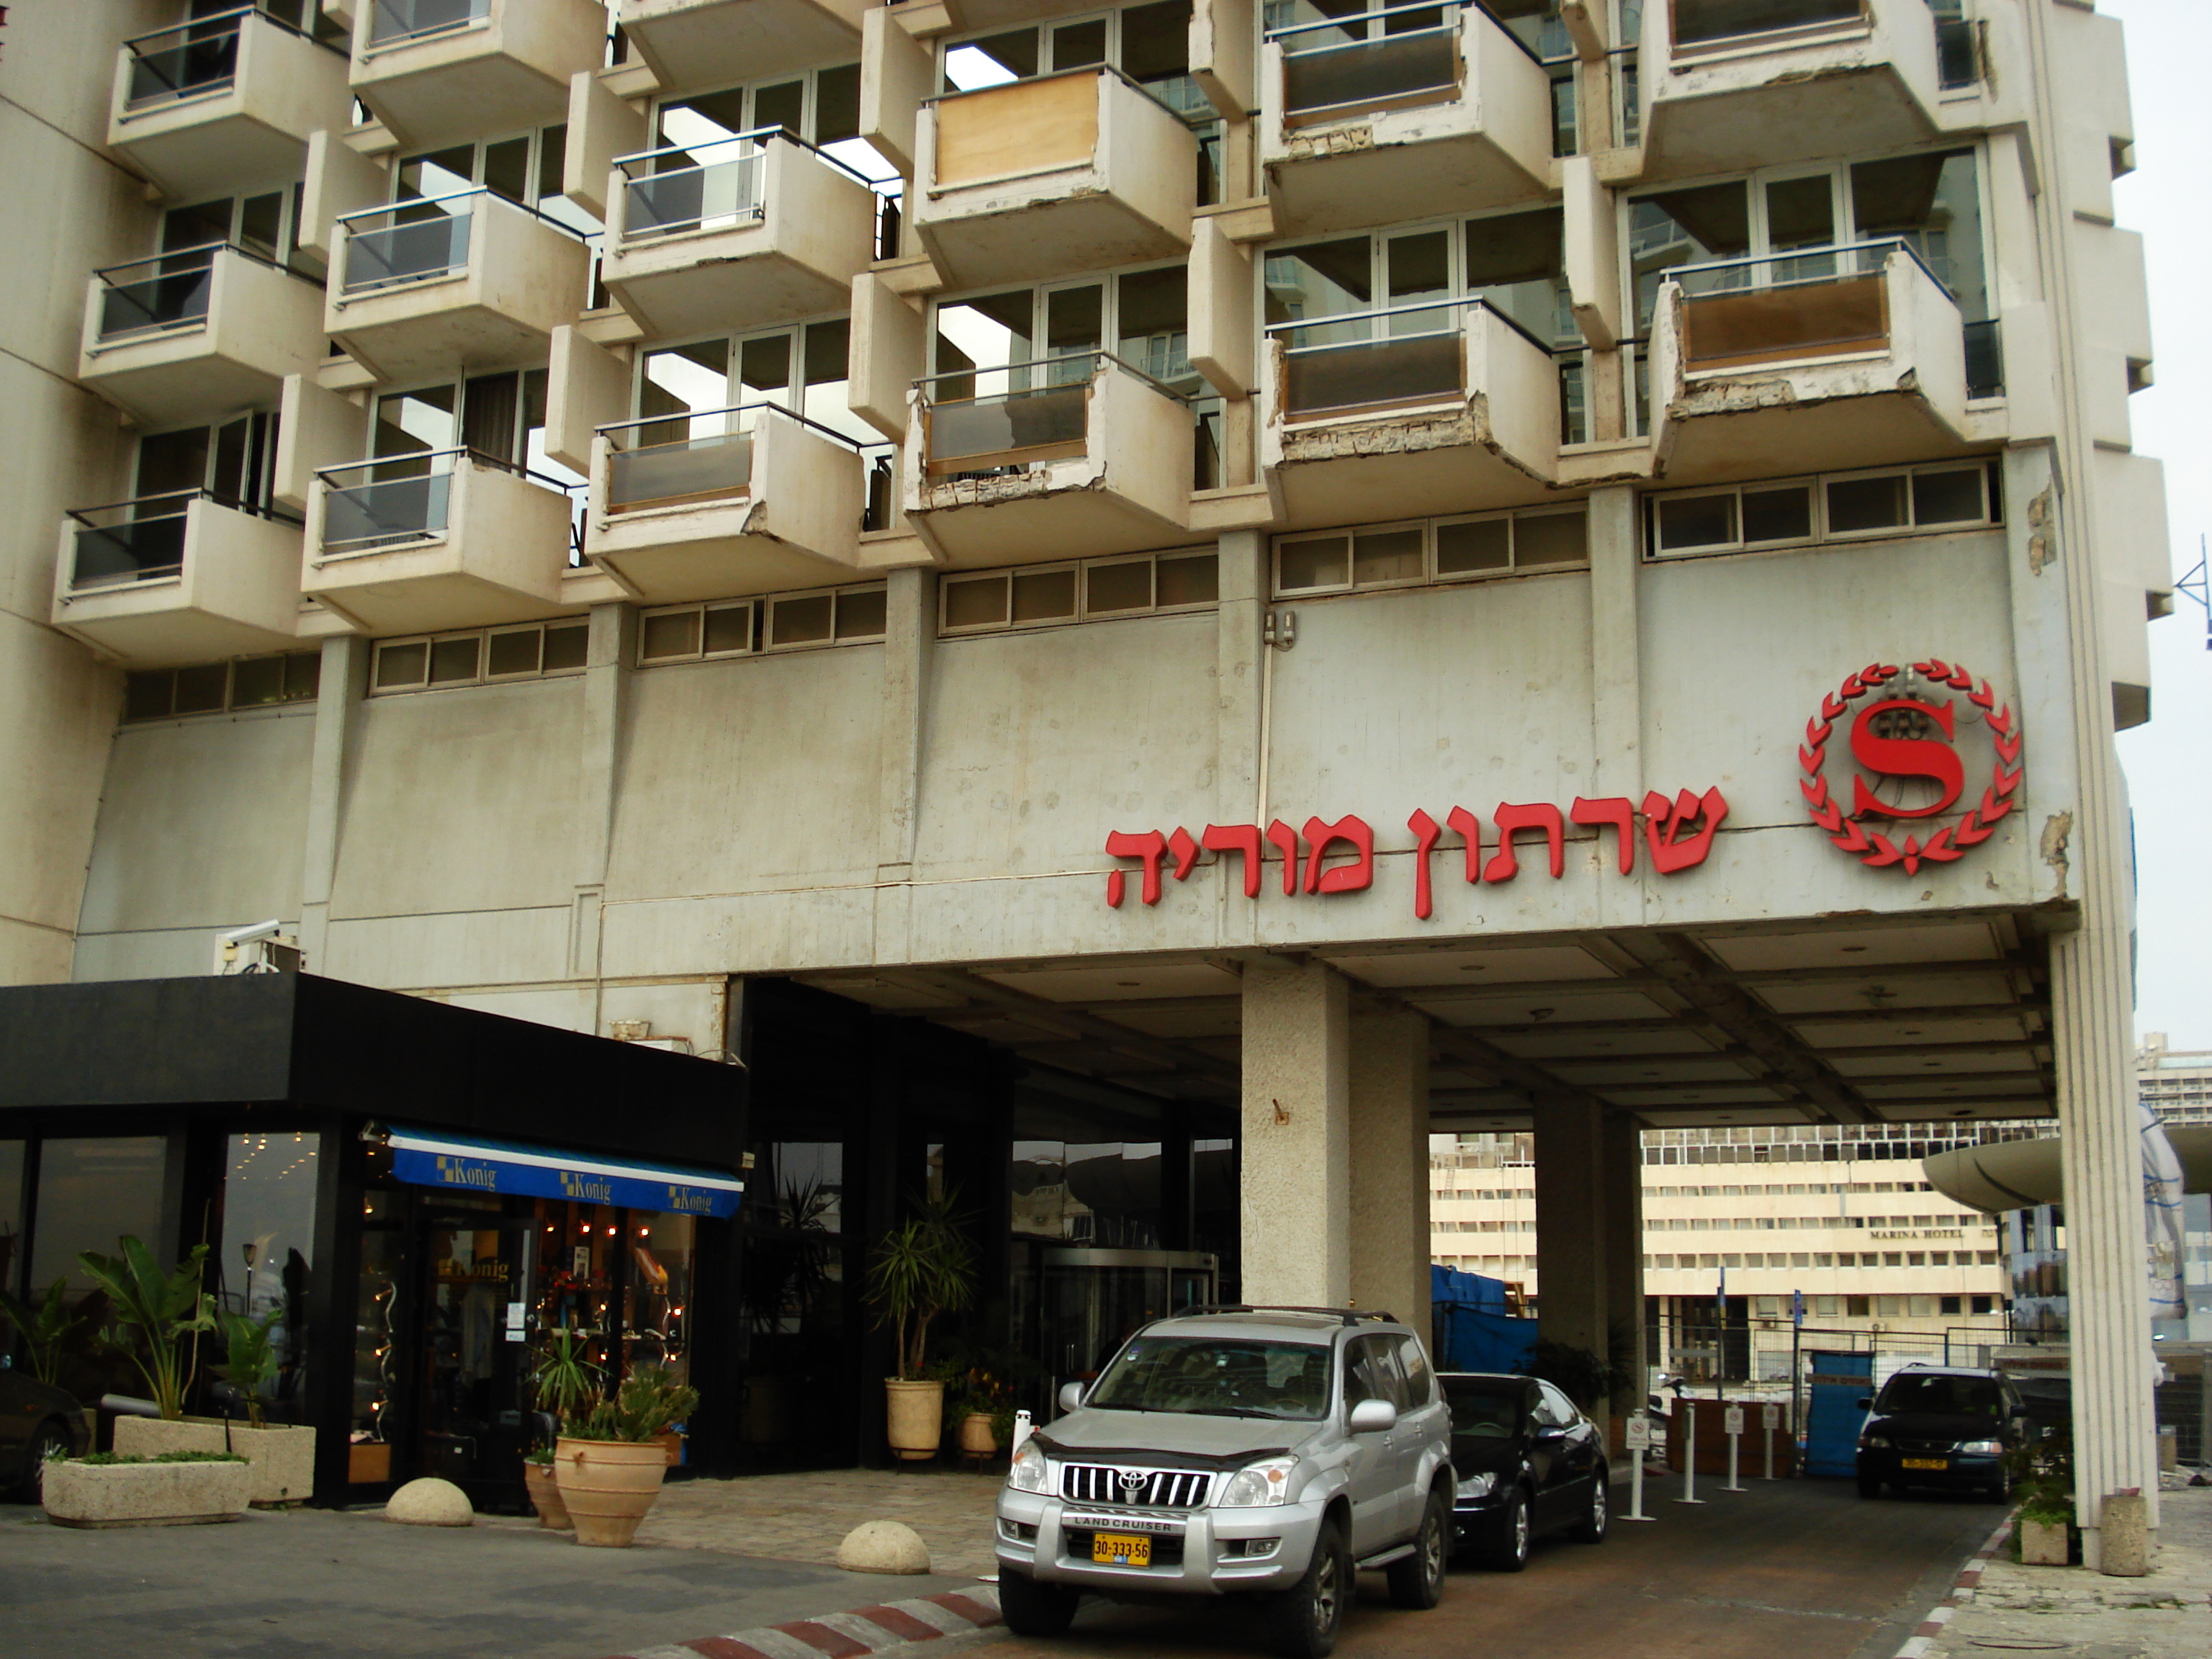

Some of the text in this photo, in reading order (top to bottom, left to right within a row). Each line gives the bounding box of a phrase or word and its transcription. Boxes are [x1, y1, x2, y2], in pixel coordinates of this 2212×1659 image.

[1851, 699, 1965, 819] S
[1105, 785, 1729, 920] שרתון מוריה
[454, 1158, 497, 1192] Konig
[574, 1173, 611, 1205] Konig
[680, 1186, 713, 1215] Konig
[1871, 1229, 1965, 1239] MARINA HOTEL
[1074, 1516, 1172, 1531] LAND CRUISER
